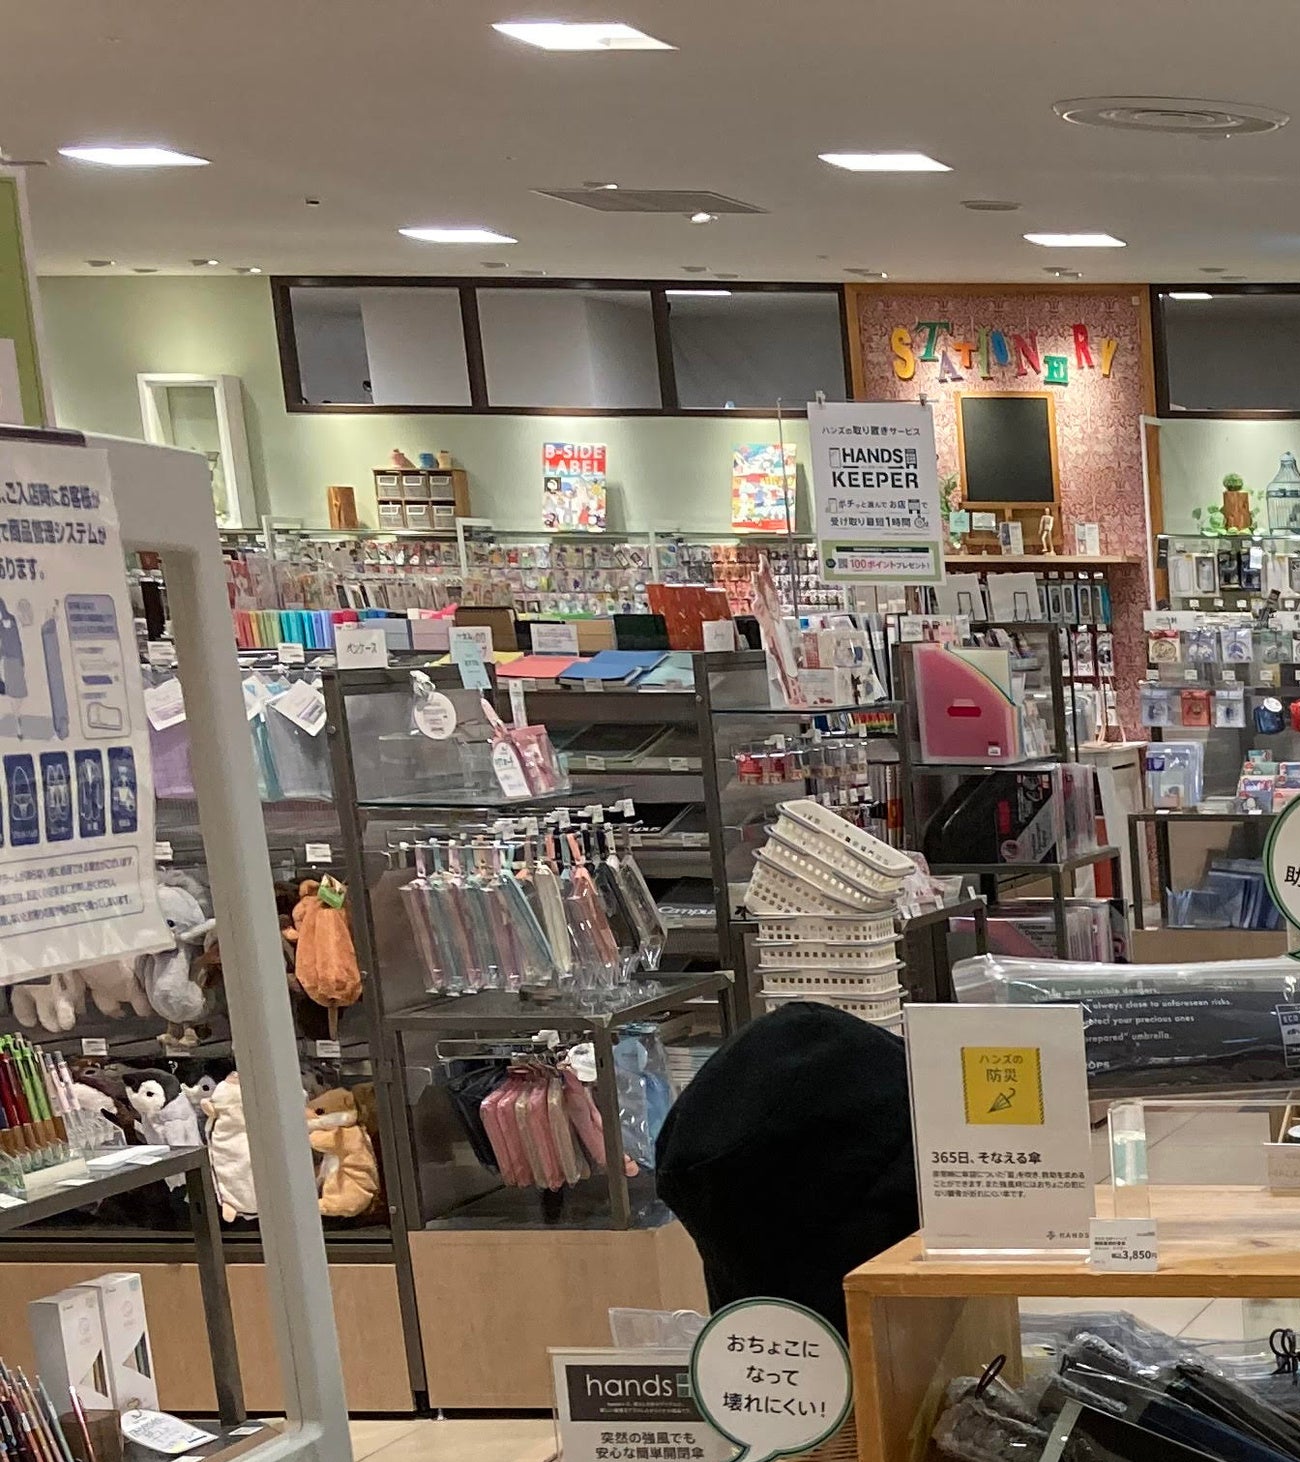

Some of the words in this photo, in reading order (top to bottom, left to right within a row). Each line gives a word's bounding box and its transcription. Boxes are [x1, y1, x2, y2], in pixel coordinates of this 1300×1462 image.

[822, 426, 920, 436] ハンズの取り置きサービス
[545, 445, 603, 459] B-SIDE
[842, 448, 903, 463] HANDS
[545, 460, 604, 475] LABEL
[832, 472, 918, 488] KEEPER
[979, 1054, 1023, 1064] ハンズの
[986, 1068, 1018, 1083] 防災
[931, 1152, 1041, 1164] 365日、そなえる傘
[727, 1334, 820, 1359] おちょこに
[746, 1365, 800, 1387] なって
[586, 1374, 673, 1398] hands
[723, 1391, 826, 1419] 壊れにくい!
[601, 1432, 696, 1444] 突然の強風でも
